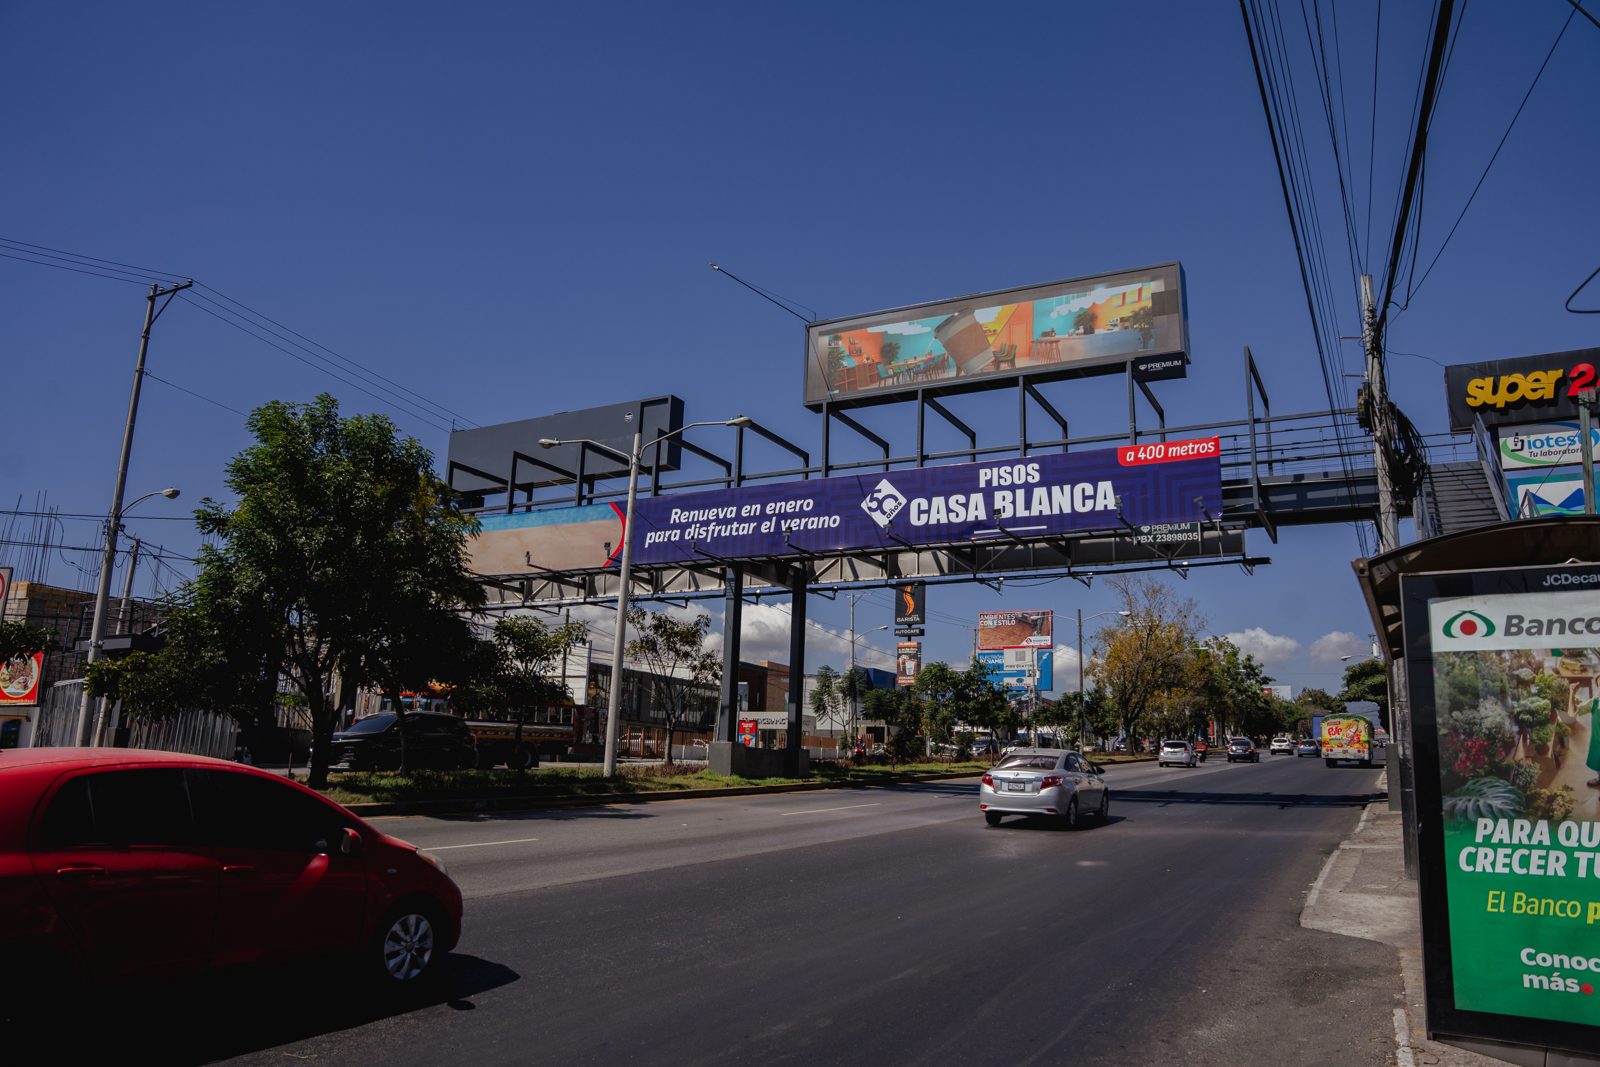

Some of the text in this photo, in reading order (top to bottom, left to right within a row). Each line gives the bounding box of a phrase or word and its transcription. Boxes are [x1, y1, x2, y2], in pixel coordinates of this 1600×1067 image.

[1147, 360, 1182, 369] PREMIUM
[1465, 362, 1600, 409] super 2
[1126, 441, 1215, 462] a 400 metros
[1529, 450, 1538, 458] Tu
[979, 462, 1041, 488] PISOS
[669, 498, 815, 524] Renueva en enero
[909, 480, 1118, 527] CASA BLANCA
[644, 514, 841, 548] para disfrutar el verano
[1135, 532, 1199, 544] PBX 23898035
[1151, 523, 1191, 532] PREMIUM
[1504, 614, 1600, 637] Banco
[1475, 817, 1551, 845] PARA
[1459, 846, 1568, 877] CRECER
[1487, 890, 1506, 913] El
[1512, 891, 1581, 918] Banco
